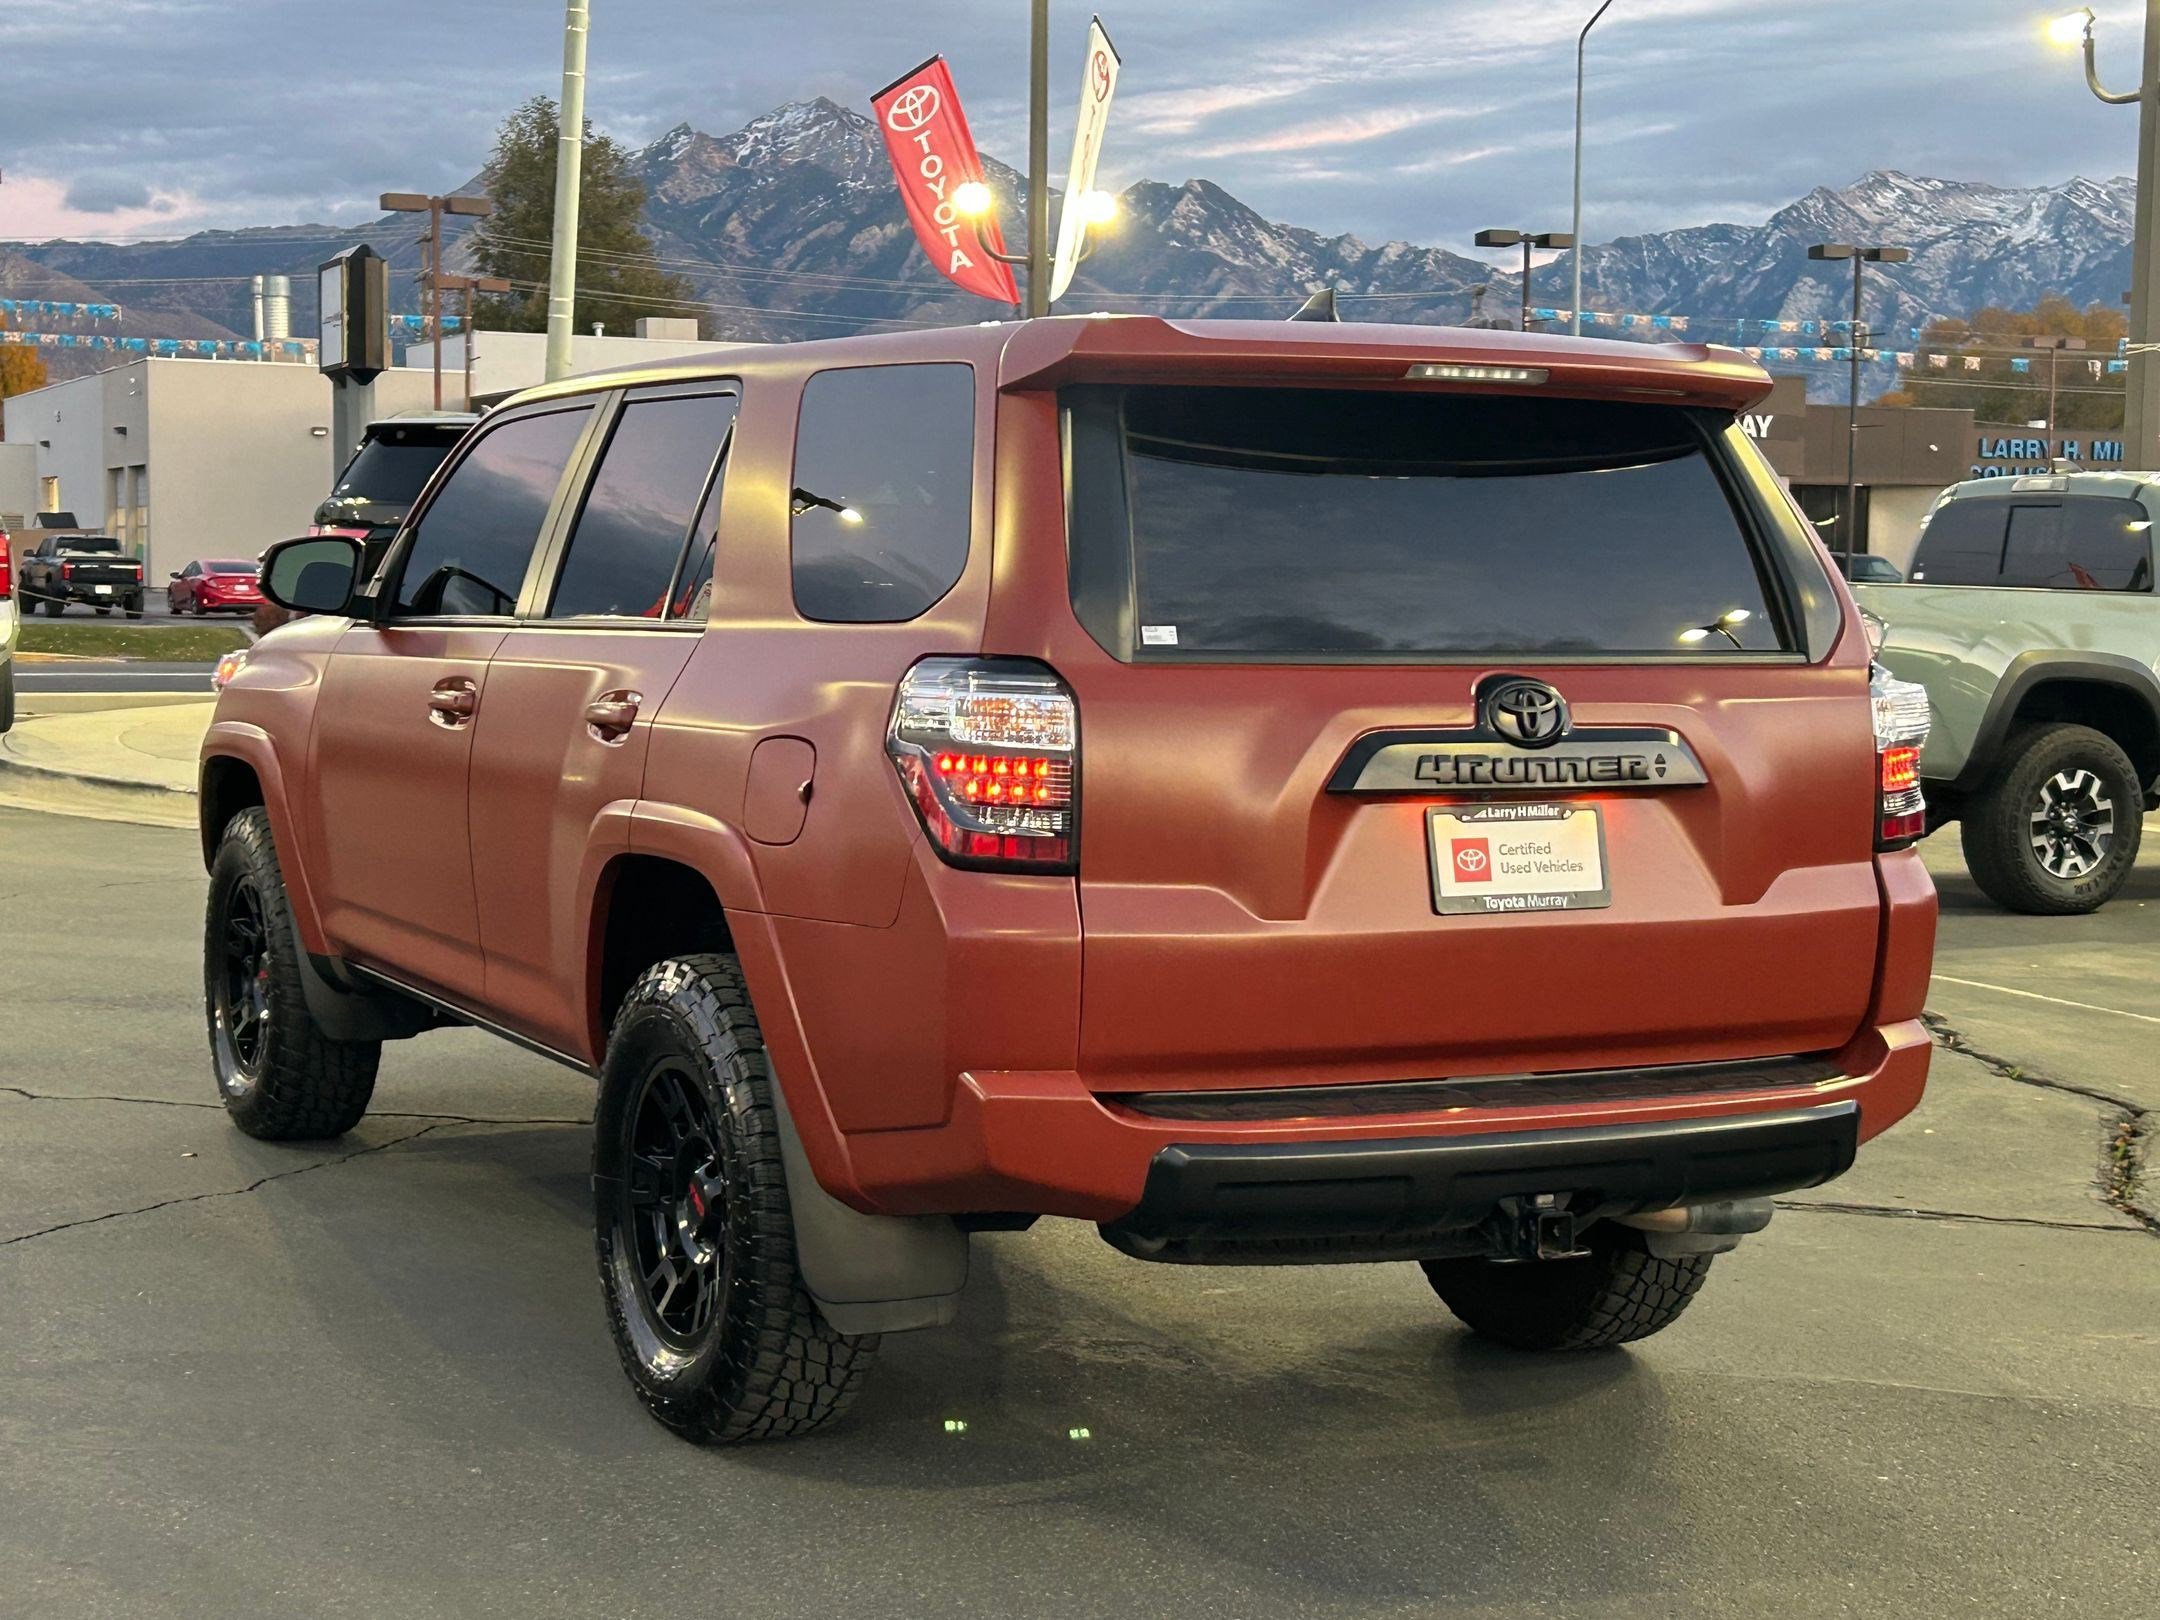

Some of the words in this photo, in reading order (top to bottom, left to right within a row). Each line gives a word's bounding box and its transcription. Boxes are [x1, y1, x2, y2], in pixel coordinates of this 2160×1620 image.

[913, 130, 974, 274] TOYOTA
[2061, 440, 2084, 460] H.
[1415, 754, 1650, 784] 4RUNNER
[1487, 807, 1516, 819] Larry
[1517, 806, 1526, 817] H
[1527, 804, 1559, 817] Miller
[1499, 841, 1551, 856] Certified
[1500, 861, 1531, 874] Used
[1533, 859, 1583, 873] Vehicles
[1483, 895, 1525, 911] Toyota
[1527, 894, 1567, 908] Murray
